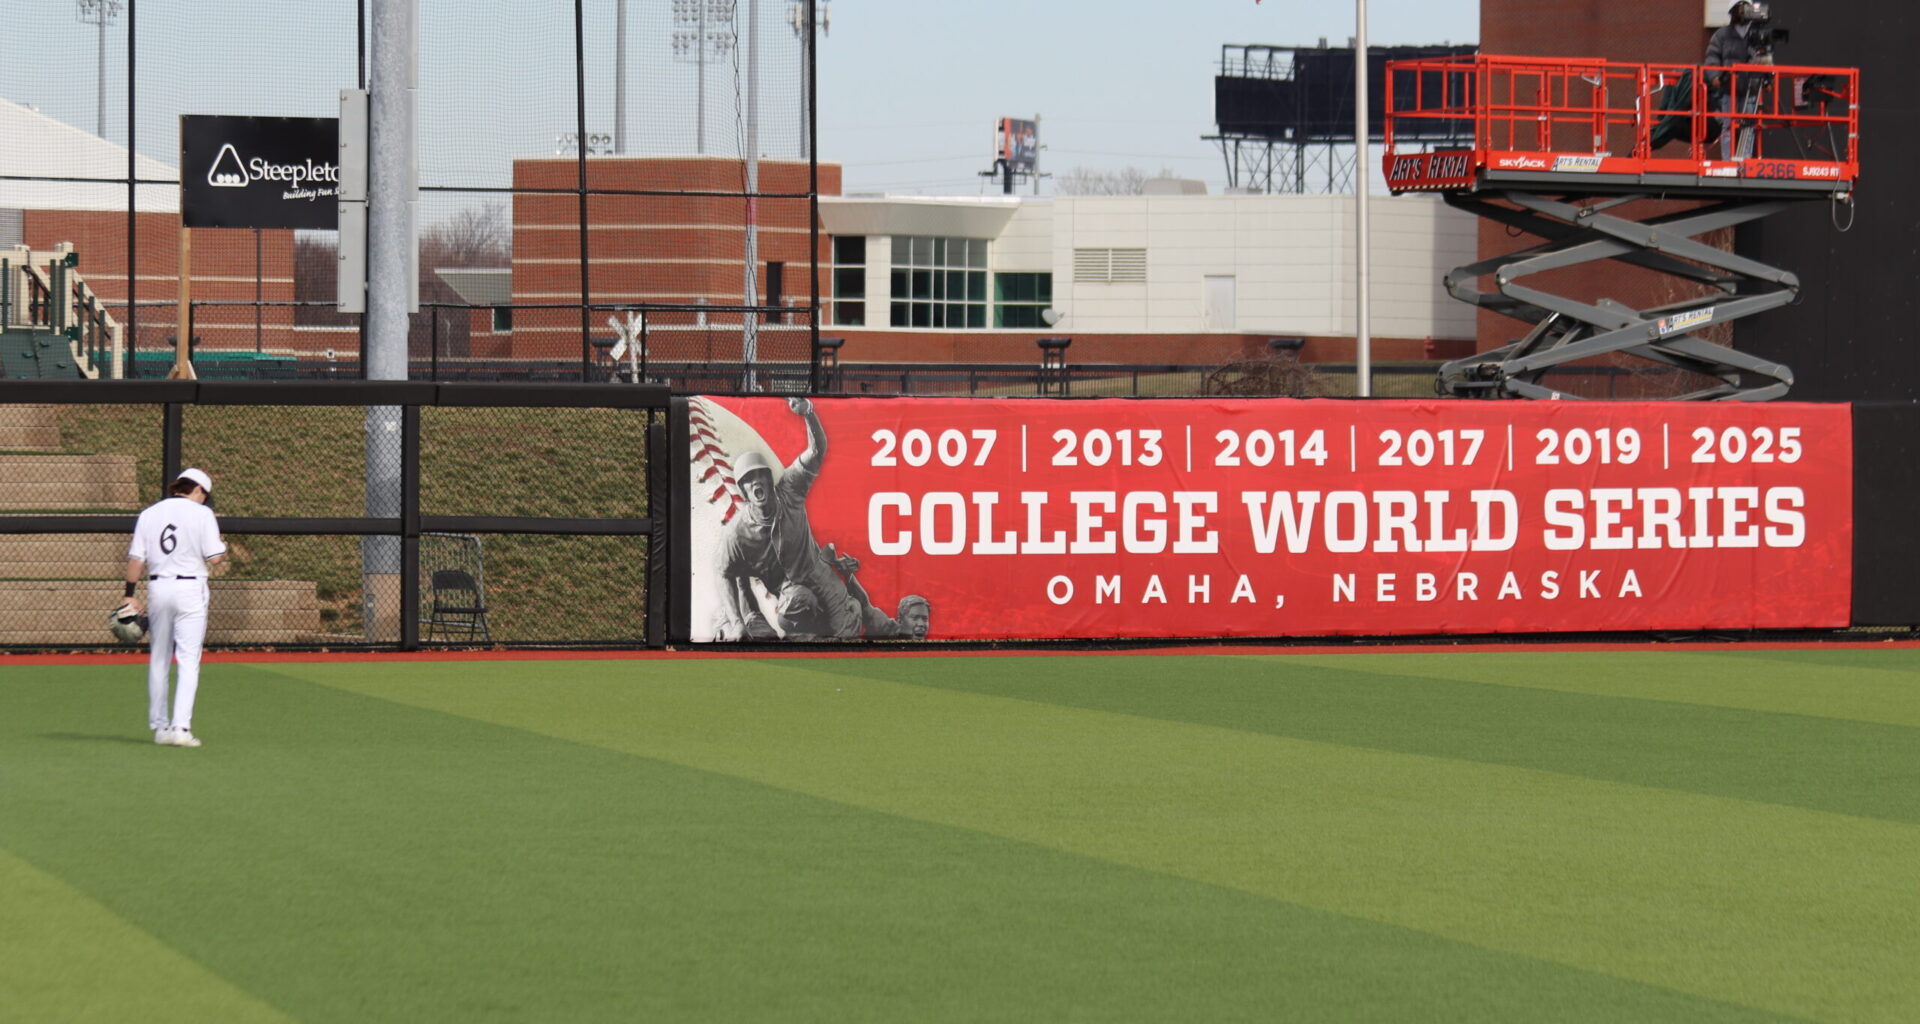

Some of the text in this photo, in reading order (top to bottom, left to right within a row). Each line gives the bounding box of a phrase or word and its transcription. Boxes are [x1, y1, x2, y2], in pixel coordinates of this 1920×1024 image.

[1389, 154, 1469, 181] ART'S RENTAL
[1499, 156, 1545, 168] SKYJACK
[1575, 157, 1599, 166] RENTAL
[283, 188, 317, 202] Building
[317, 187, 333, 197] Fun
[870, 426, 1803, 467] 2007 2013 2014 2017 2019 2025
[867, 486, 1806, 556] COLLEGE WORLD SERIES
[159, 523, 177, 556] 6
[1046, 568, 1643, 609] OMAHA, NEBRASKA
